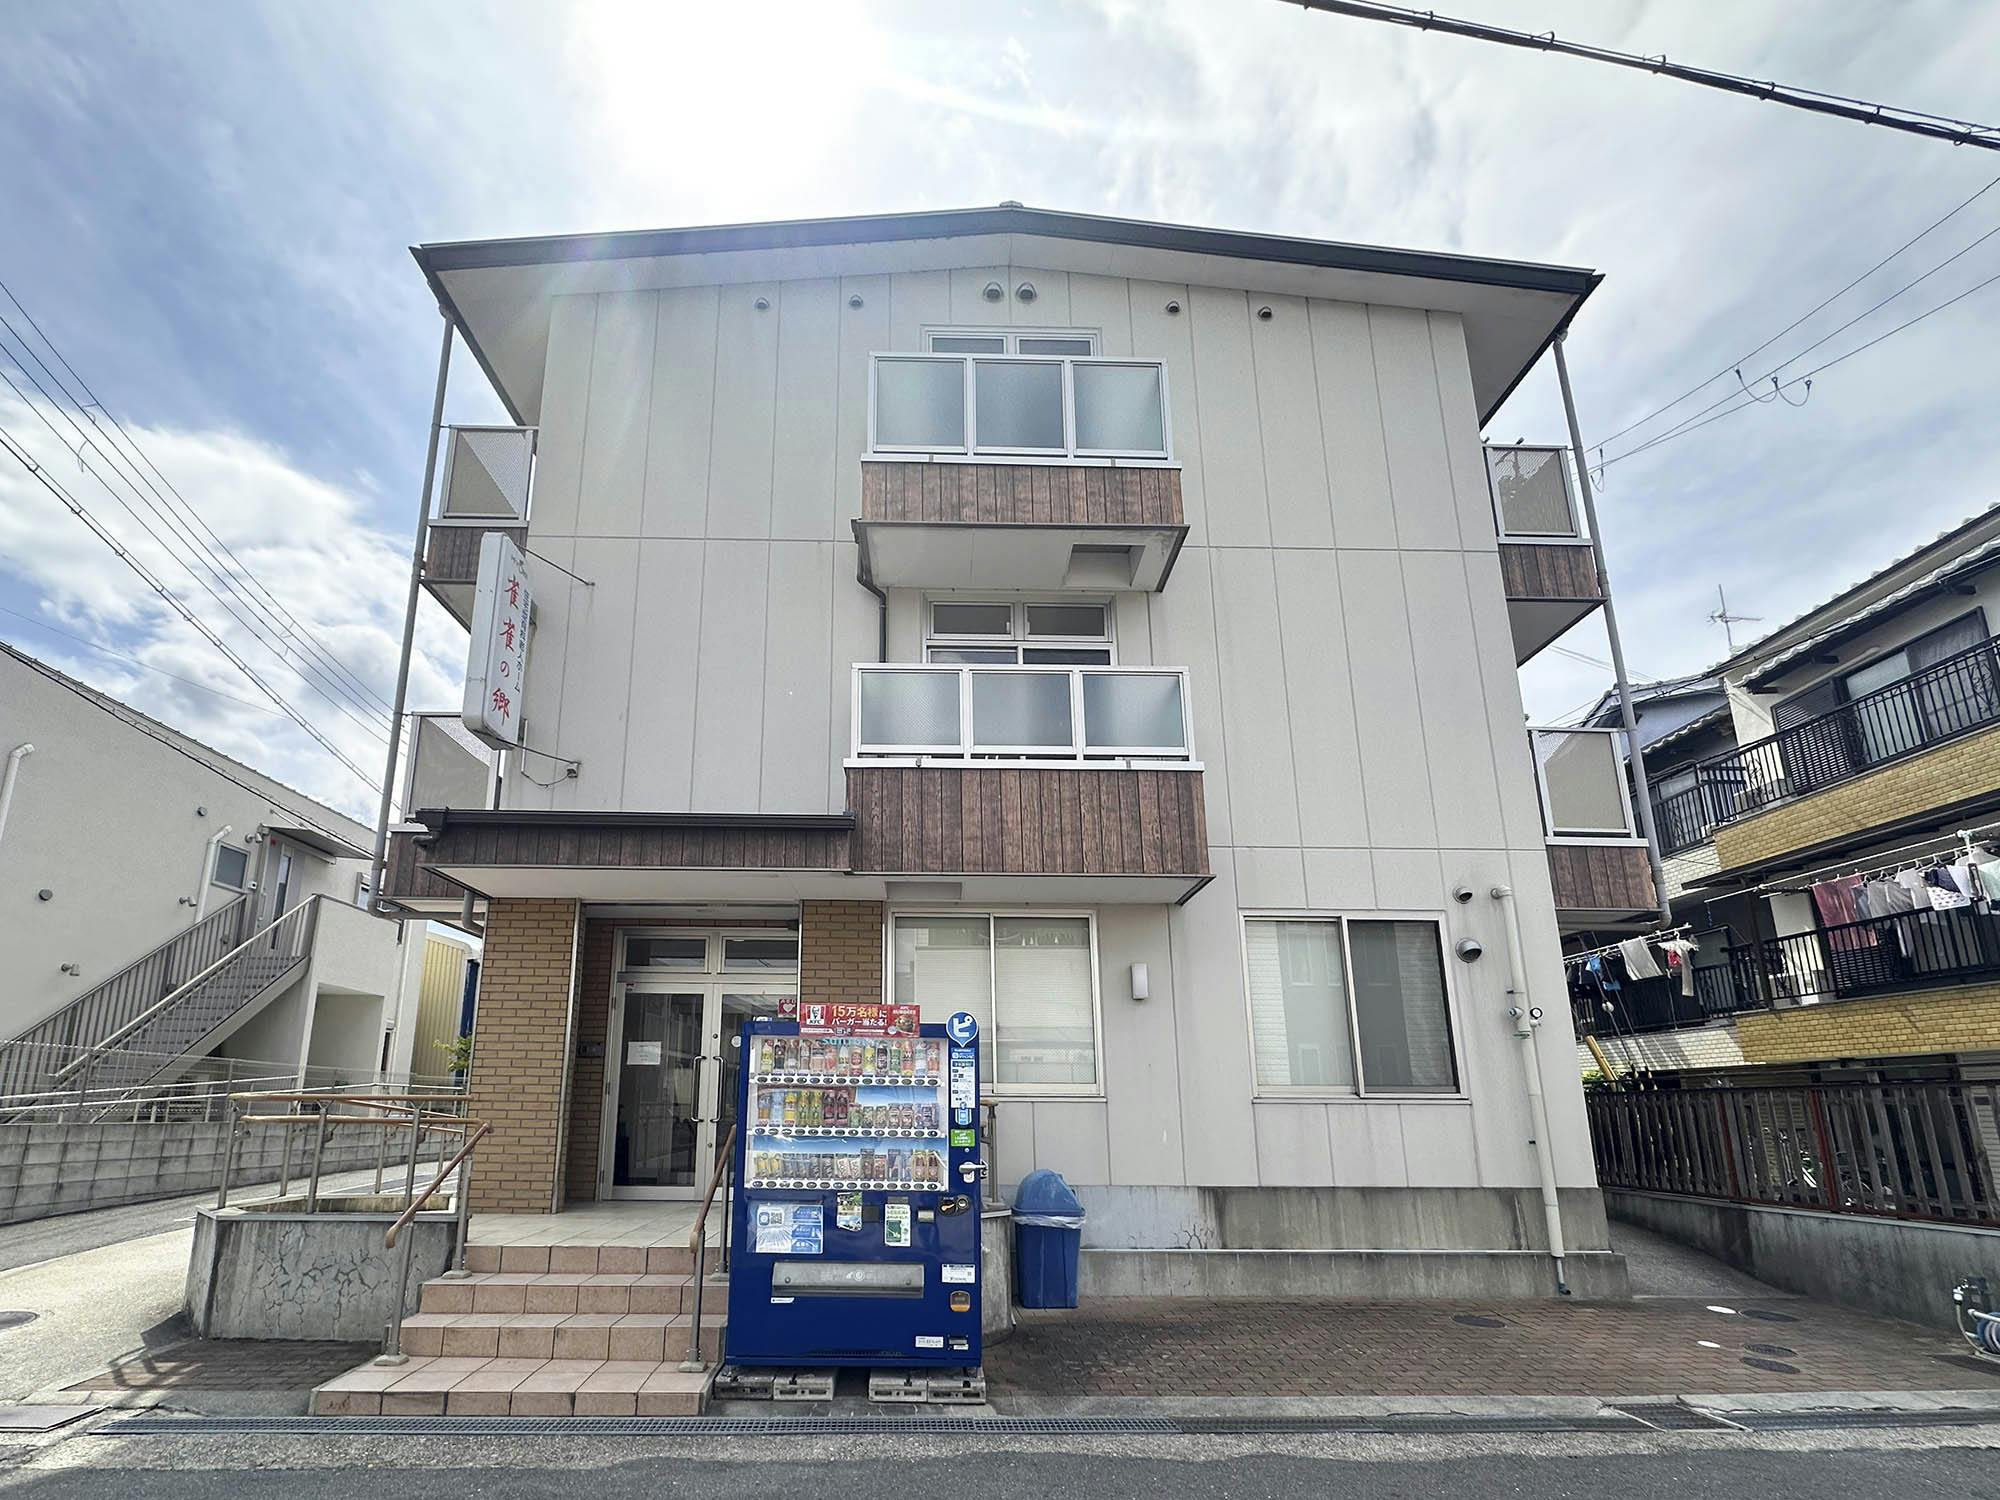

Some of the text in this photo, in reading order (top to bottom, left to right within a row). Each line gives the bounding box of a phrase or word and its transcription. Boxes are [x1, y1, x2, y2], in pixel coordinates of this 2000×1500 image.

[831, 1005, 888, 1018] 15万名様に
[831, 1017, 888, 1026] バーガー当たる!
